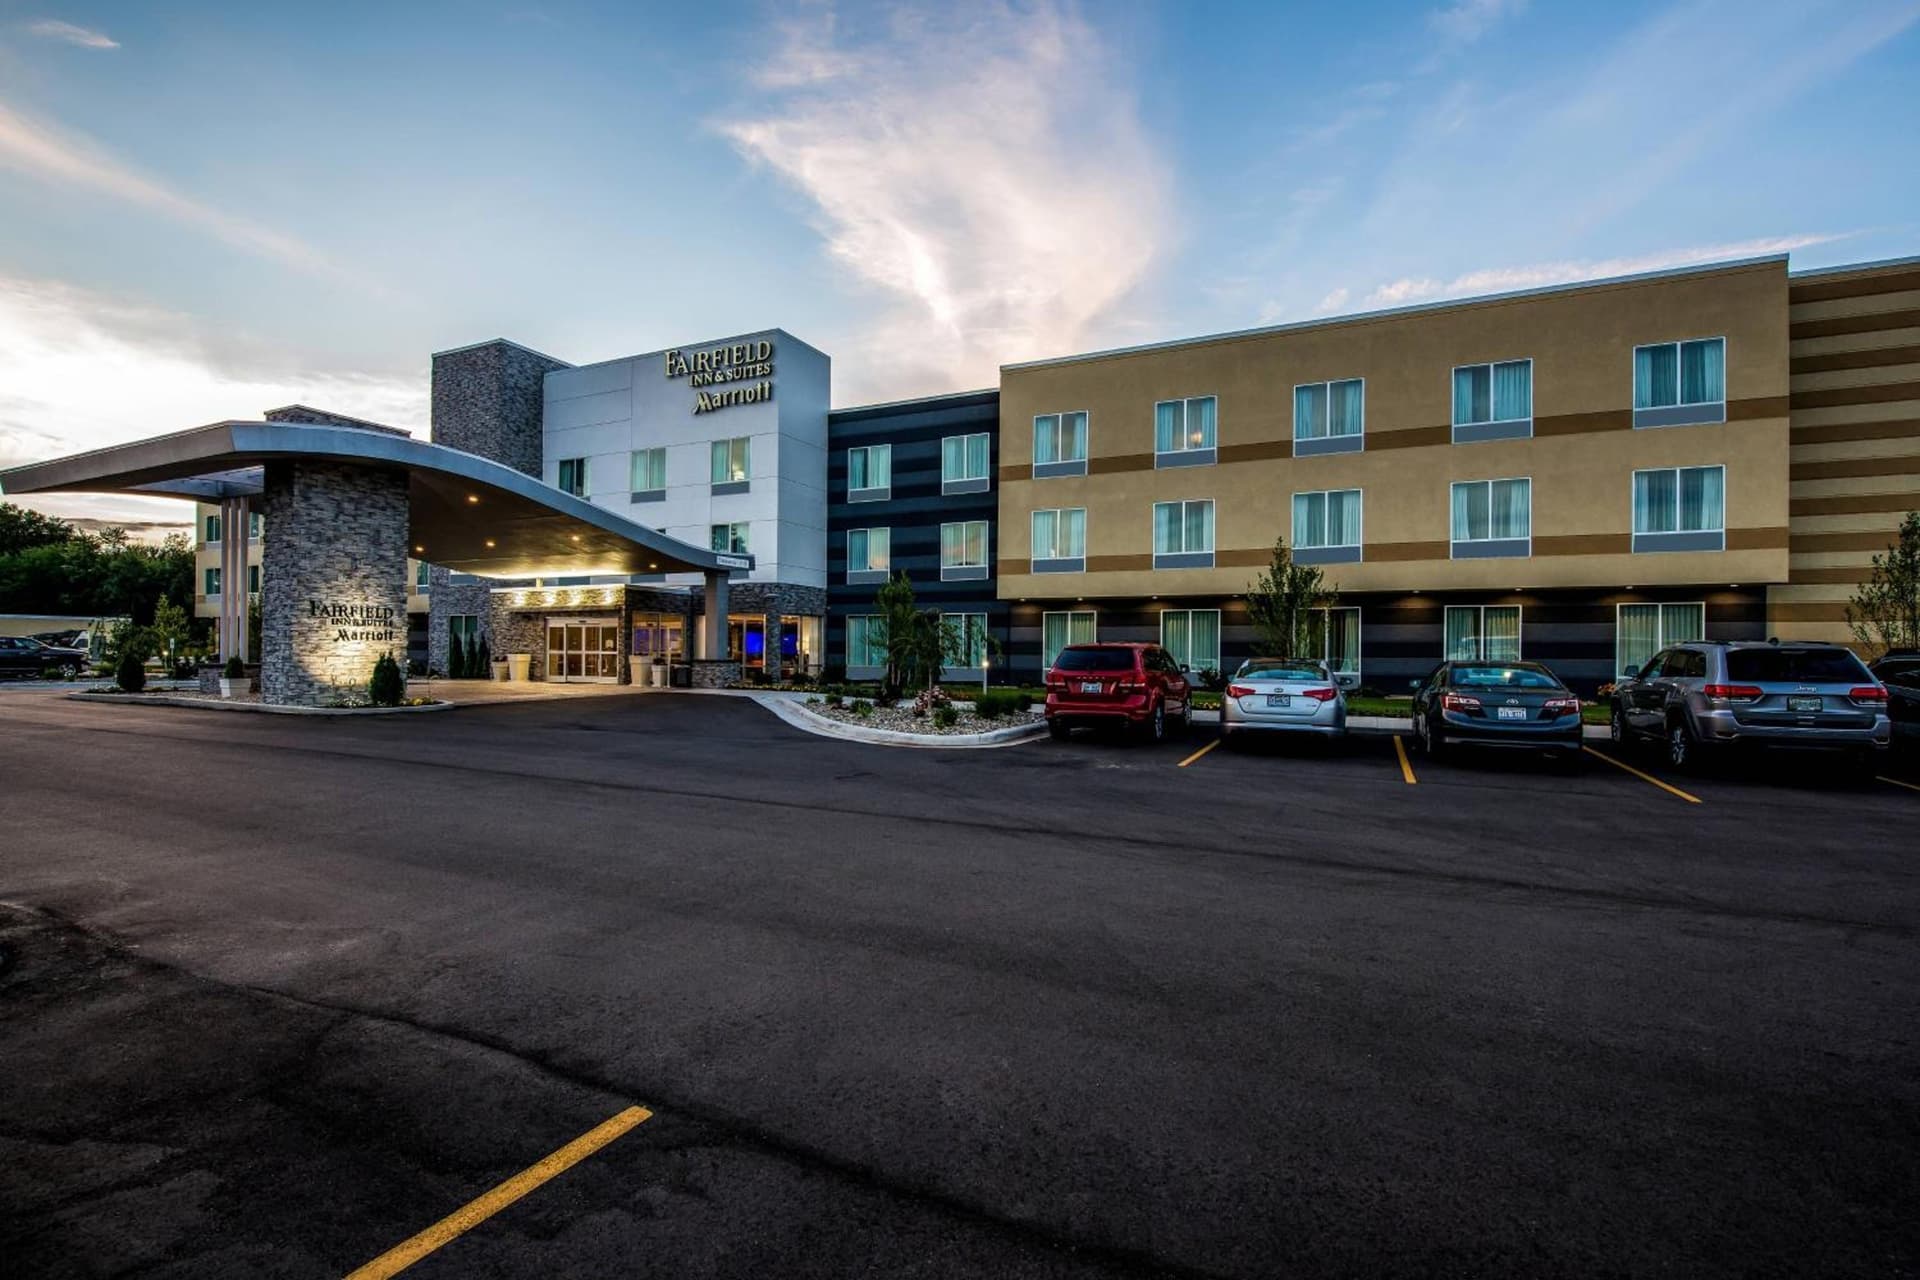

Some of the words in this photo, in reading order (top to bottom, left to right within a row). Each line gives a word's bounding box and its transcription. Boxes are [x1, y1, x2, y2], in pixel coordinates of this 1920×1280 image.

[665, 340, 772, 377] FAIRFIELD
[689, 372, 713, 387] INN
[714, 370, 725, 382] &
[726, 362, 771, 381] SUITES
[692, 380, 772, 415] Marriott
[308, 600, 394, 619] FAIRFIELD
[333, 628, 394, 642] Marriott
